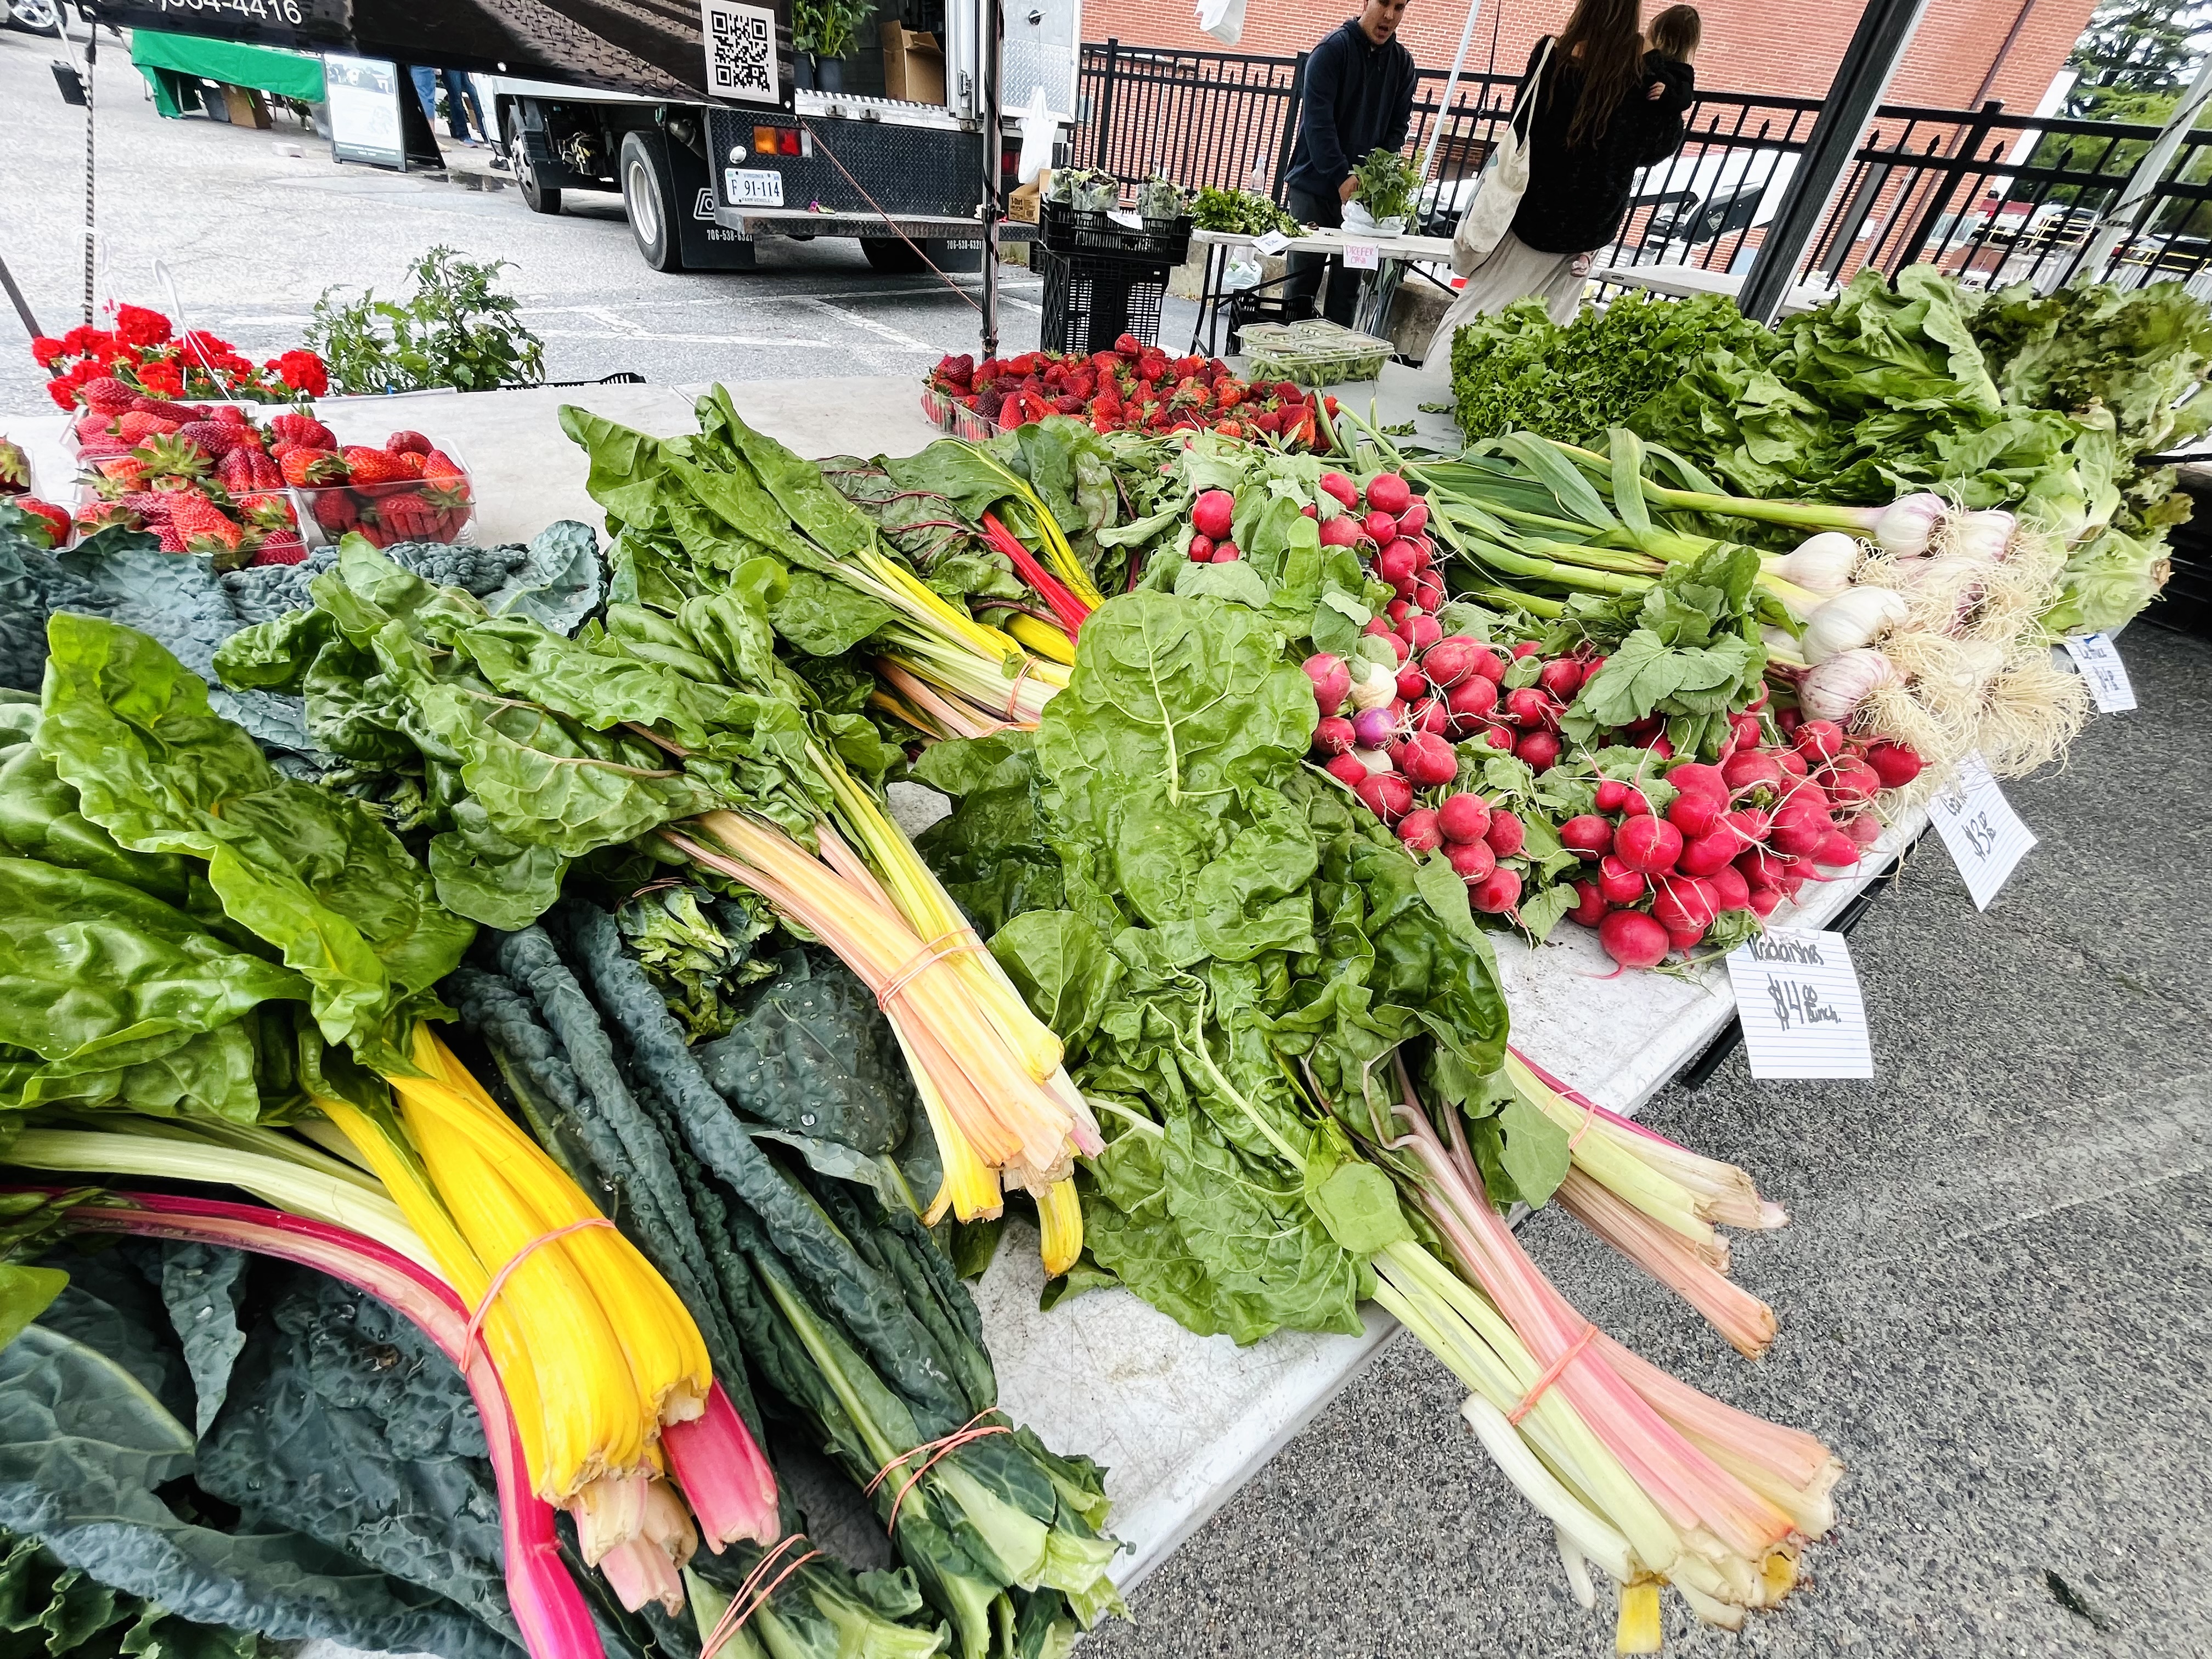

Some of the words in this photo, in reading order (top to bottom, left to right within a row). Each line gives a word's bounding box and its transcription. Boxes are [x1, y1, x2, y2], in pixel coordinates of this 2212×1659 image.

[731, 179, 738, 195] F
[744, 180, 780, 196] 91-114
[946, 239, 981, 250] 706-538-6321
[1345, 245, 1374, 257] PREFER
